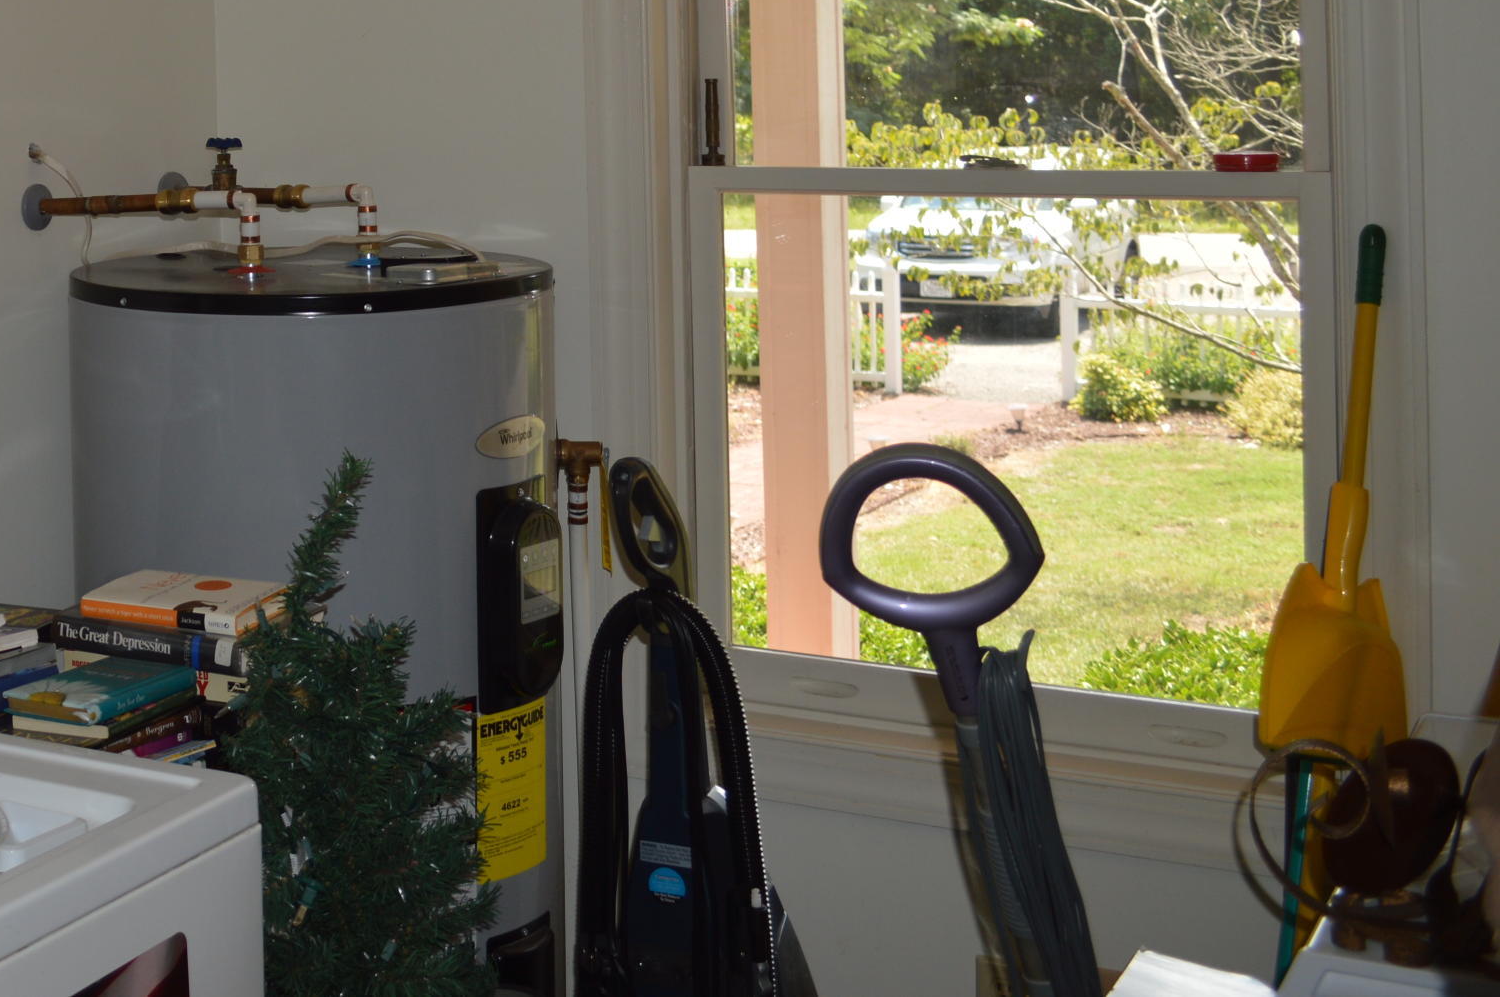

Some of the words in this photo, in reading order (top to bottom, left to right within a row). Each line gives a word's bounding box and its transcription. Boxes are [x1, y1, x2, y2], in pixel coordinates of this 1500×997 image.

[500, 426, 532, 446] Whirlpool
[57, 620, 79, 639] The
[79, 623, 109, 645] Great
[112, 631, 171, 655] Depression
[480, 706, 544, 740] ENERGYGUIDE
[507, 747, 527, 764] 555
[501, 799, 521, 812] 4622
